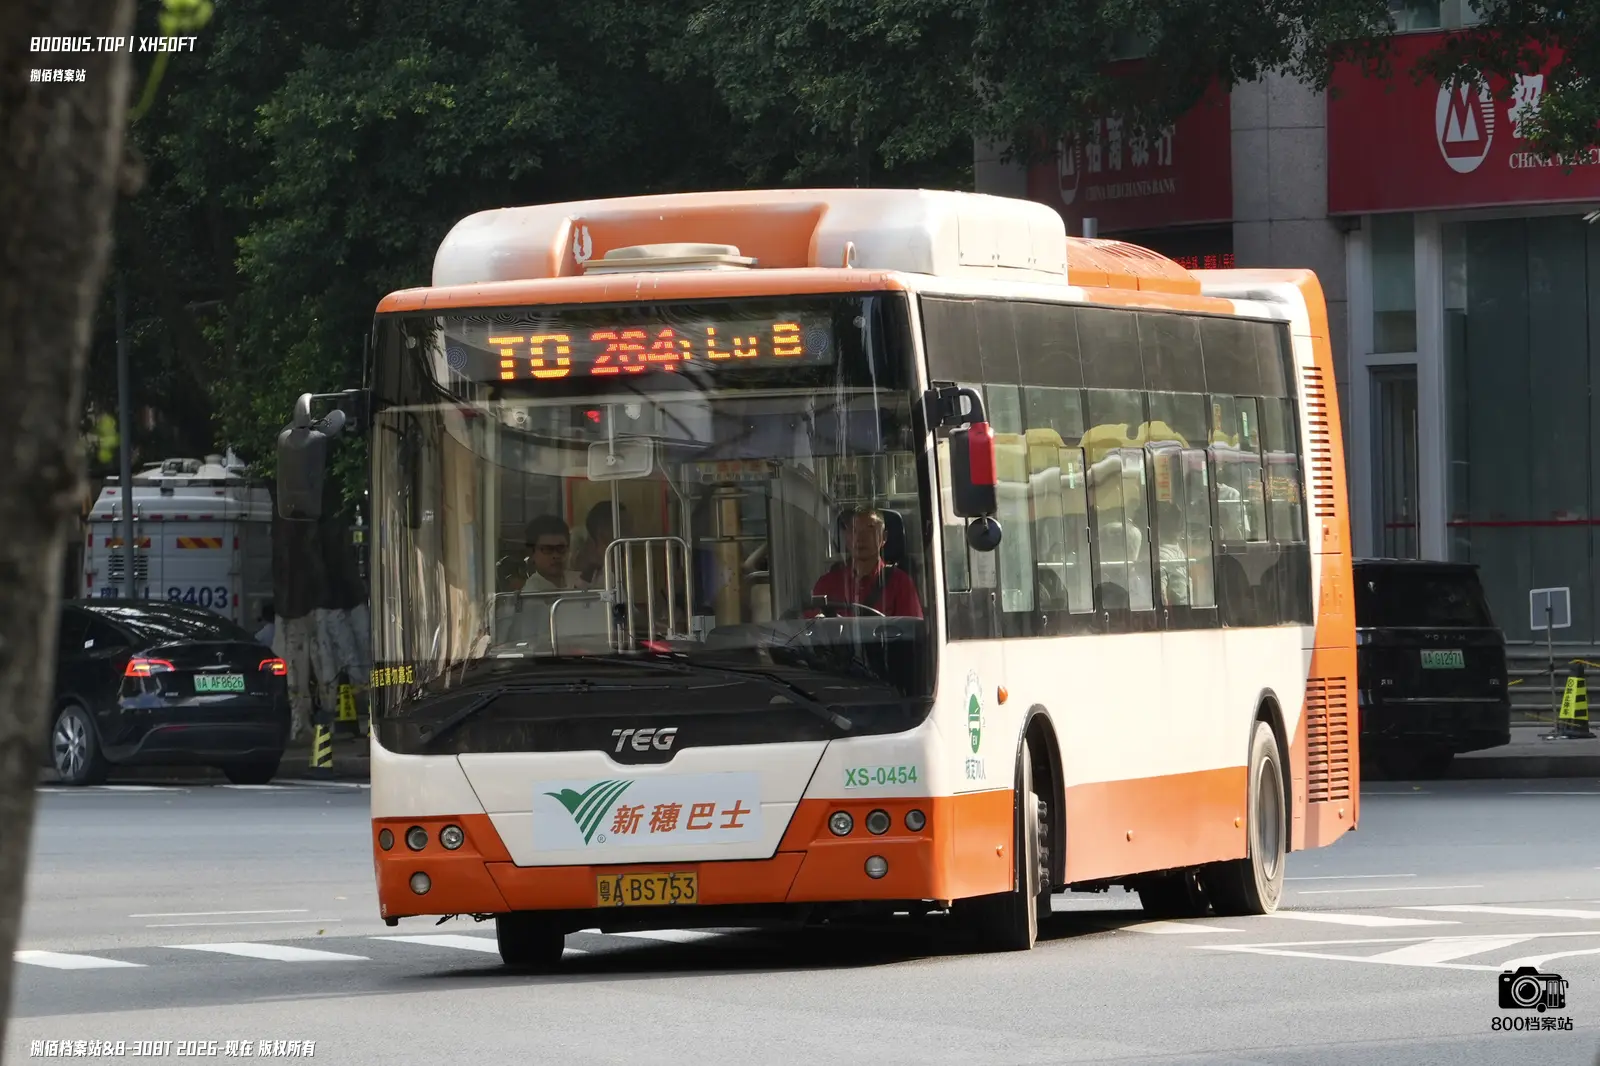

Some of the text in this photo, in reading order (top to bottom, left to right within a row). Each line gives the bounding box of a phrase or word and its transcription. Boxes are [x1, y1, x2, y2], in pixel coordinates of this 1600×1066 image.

[489, 334, 571, 380] TO
[591, 328, 680, 375] 264
[167, 586, 228, 609] 8403
[212, 676, 243, 688] AF8626
[611, 727, 678, 752] TEG
[845, 766, 917, 787] XS-0454
[610, 800, 750, 835] 新穗巴士
